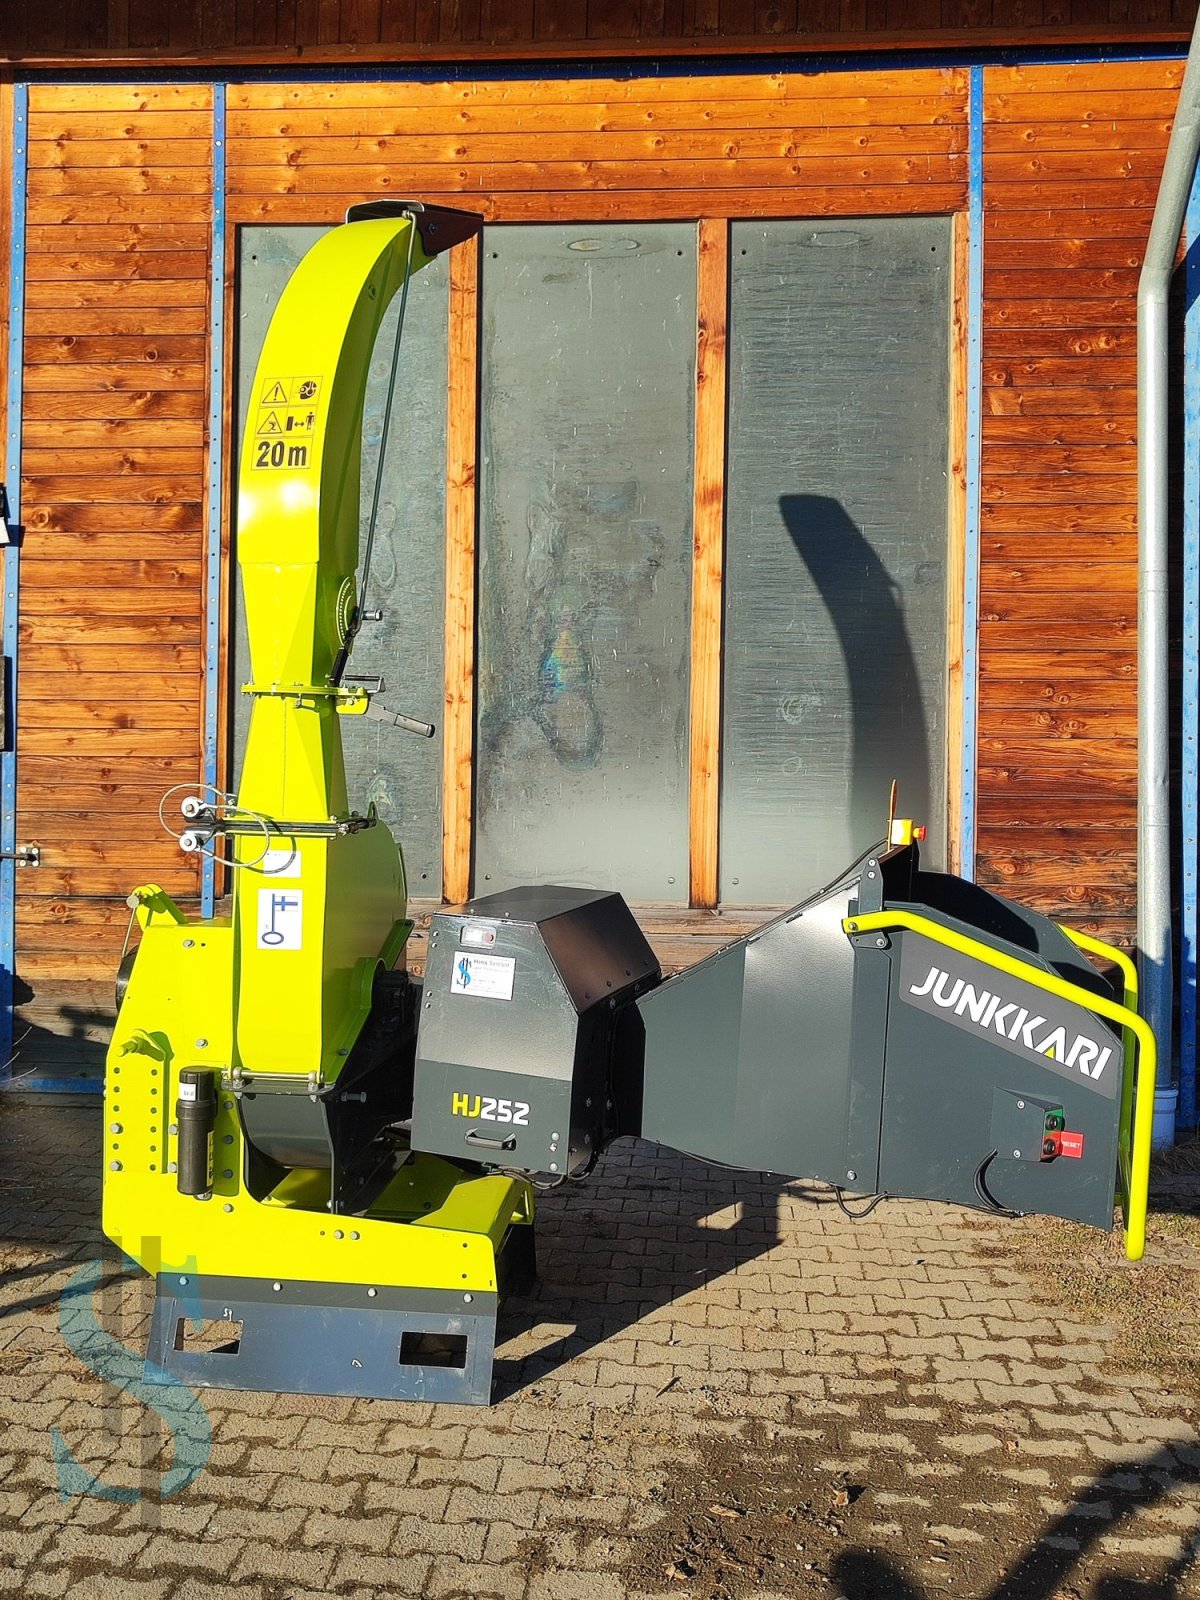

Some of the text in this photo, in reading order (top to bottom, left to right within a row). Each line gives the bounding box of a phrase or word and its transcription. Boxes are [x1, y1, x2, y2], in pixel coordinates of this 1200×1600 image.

[256, 440, 307, 467] 20 m
[909, 966, 1113, 1081] JUNKKARI
[452, 1092, 530, 1126] HJ252
